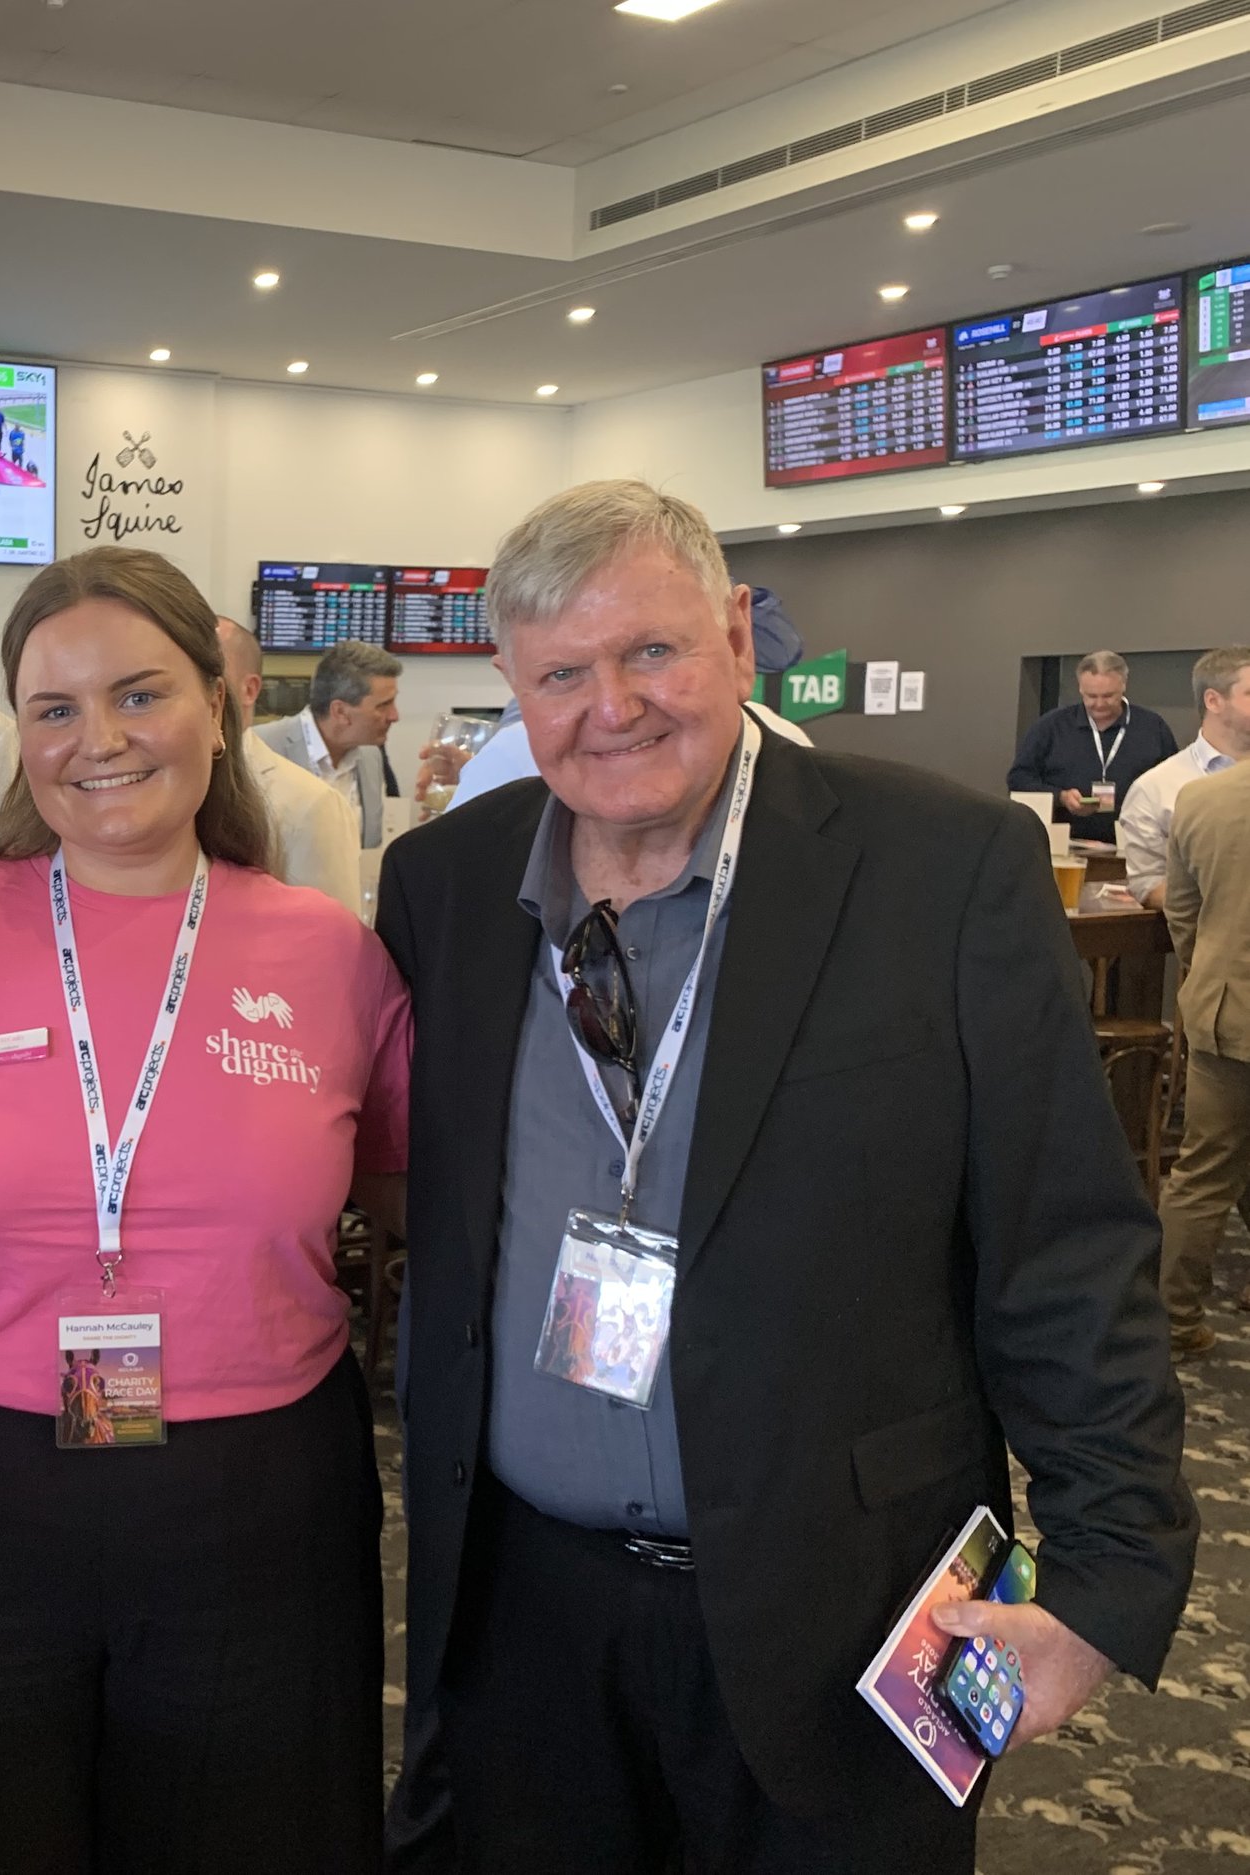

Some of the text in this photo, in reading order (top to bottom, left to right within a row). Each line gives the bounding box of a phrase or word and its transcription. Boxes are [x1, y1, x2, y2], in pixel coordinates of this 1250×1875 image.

[81, 452, 183, 499] James
[80, 495, 182, 541] Squire
[788, 675, 839, 704] TAB
[206, 1028, 288, 1063] share
[66, 1321, 153, 1333] Hannah McCauley
[105, 1386, 158, 1398] RACE DAY
[107, 1376, 156, 1387] CHARITY
[912, 1649, 937, 1677] AY
